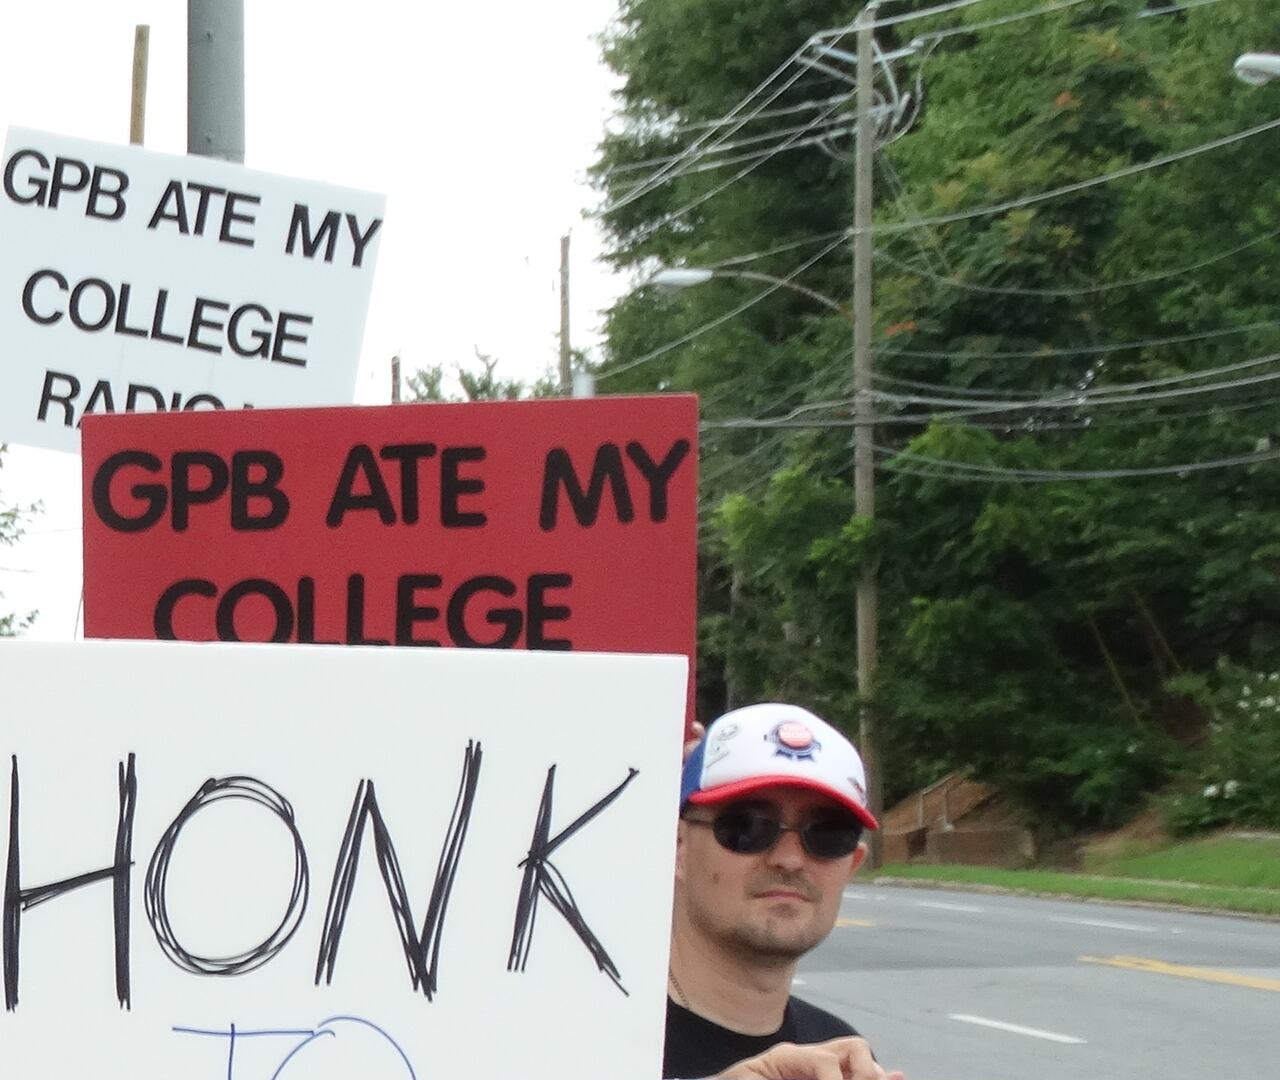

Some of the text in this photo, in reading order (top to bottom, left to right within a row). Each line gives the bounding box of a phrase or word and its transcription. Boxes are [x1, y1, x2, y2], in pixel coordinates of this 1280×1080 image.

[2, 148, 383, 269] GPB ATE MY
[21, 267, 314, 369] COLLEGE
[91, 437, 691, 534] GPB ATE MY
[153, 571, 574, 651] COLLEGE
[2, 737, 640, 1013] HONK
